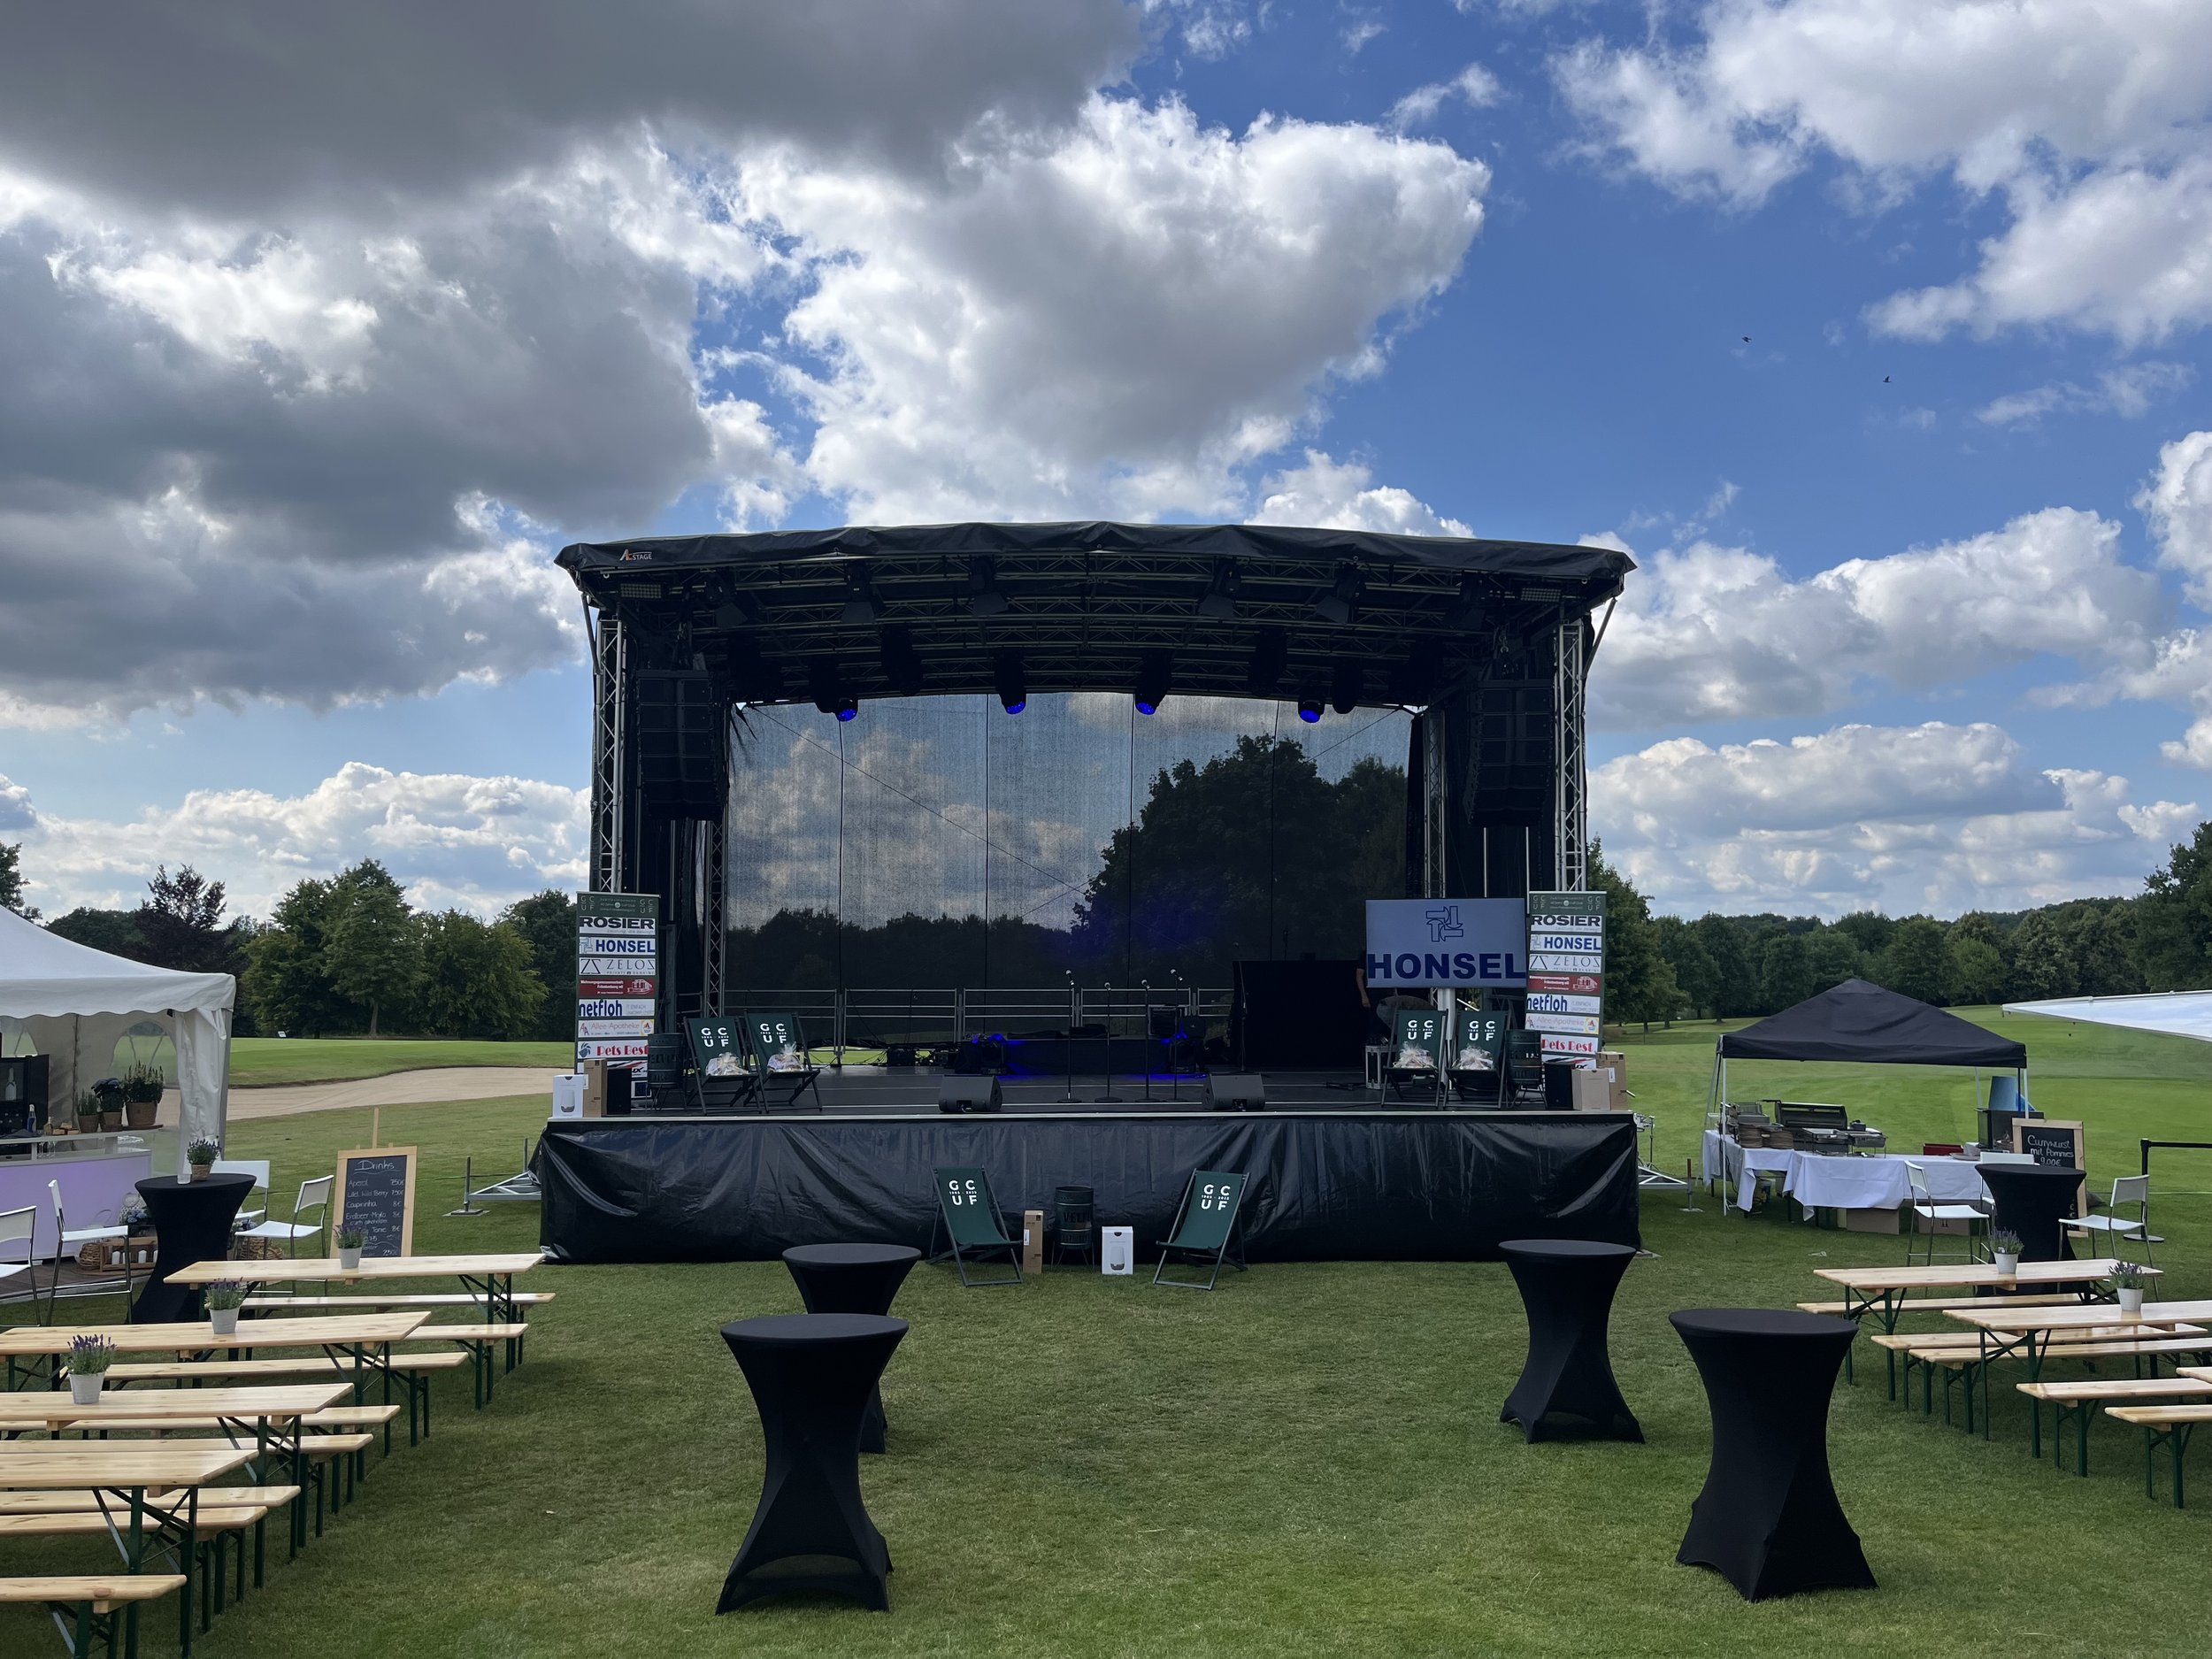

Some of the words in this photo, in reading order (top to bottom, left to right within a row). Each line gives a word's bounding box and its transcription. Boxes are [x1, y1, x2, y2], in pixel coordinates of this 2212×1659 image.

[579, 917, 654, 929] ROSIER
[1532, 915, 1601, 926] ROSIER
[595, 940, 655, 952] HONSEL
[1544, 937, 1601, 950] HONSEL
[1368, 953, 1526, 979] HONSEL
[1527, 994, 1567, 1011] netfloh
[580, 1000, 622, 1017] netfloh
[760, 1023, 770, 1032] G
[776, 1023, 785, 1032] C
[596, 1046, 621, 1056] Pets
[1541, 1039, 1565, 1050] Pets
[1568, 1041, 1593, 1052] Best
[2027, 1134, 2071, 1149] Currywurst
[2047, 1148, 2074, 1157] Pommes
[354, 1160, 395, 1171] Drinks
[949, 1180, 959, 1191] G
[965, 1179, 975, 1190] C
[1204, 1184, 1214, 1194] G
[1221, 1186, 1231, 1195] C
[373, 1189, 388, 1198] Berry
[952, 1195, 962, 1205] U
[969, 1195, 977, 1205] F
[1202, 1199, 1211, 1210] U
[1217, 1201, 1227, 1210] F
